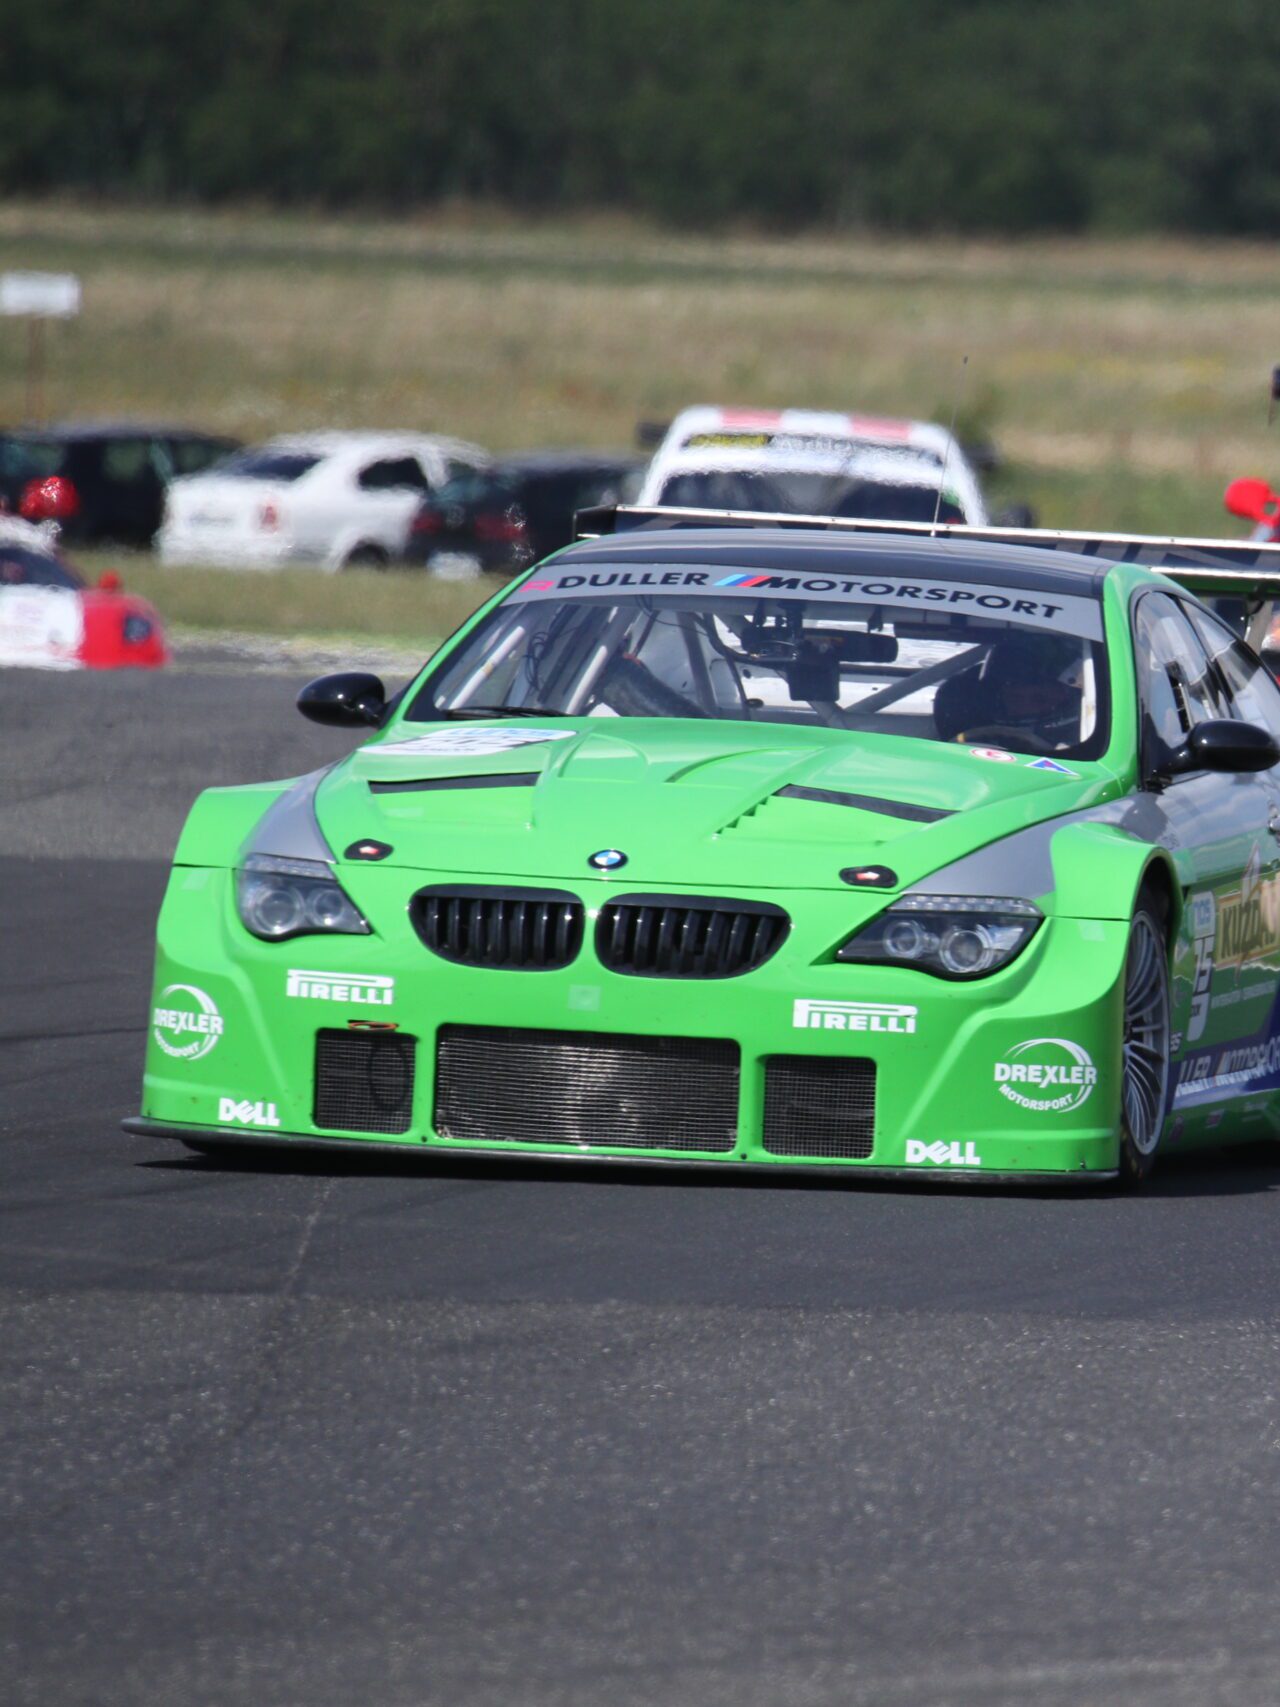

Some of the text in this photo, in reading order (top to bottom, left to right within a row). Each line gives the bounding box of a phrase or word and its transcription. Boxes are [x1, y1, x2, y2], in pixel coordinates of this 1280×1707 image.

[556, 572, 710, 589] DULLER
[755, 575, 1064, 619] MOTORSPORT
[286, 968, 394, 1005] PIRELLI
[154, 1008, 224, 1035] DREXLER
[792, 998, 918, 1034] PIRELLI
[994, 1062, 1097, 1089] DREXLER
[998, 1083, 1074, 1111] MOTORSPORT
[218, 1097, 280, 1127] DELL
[905, 1139, 981, 1166] DELL
